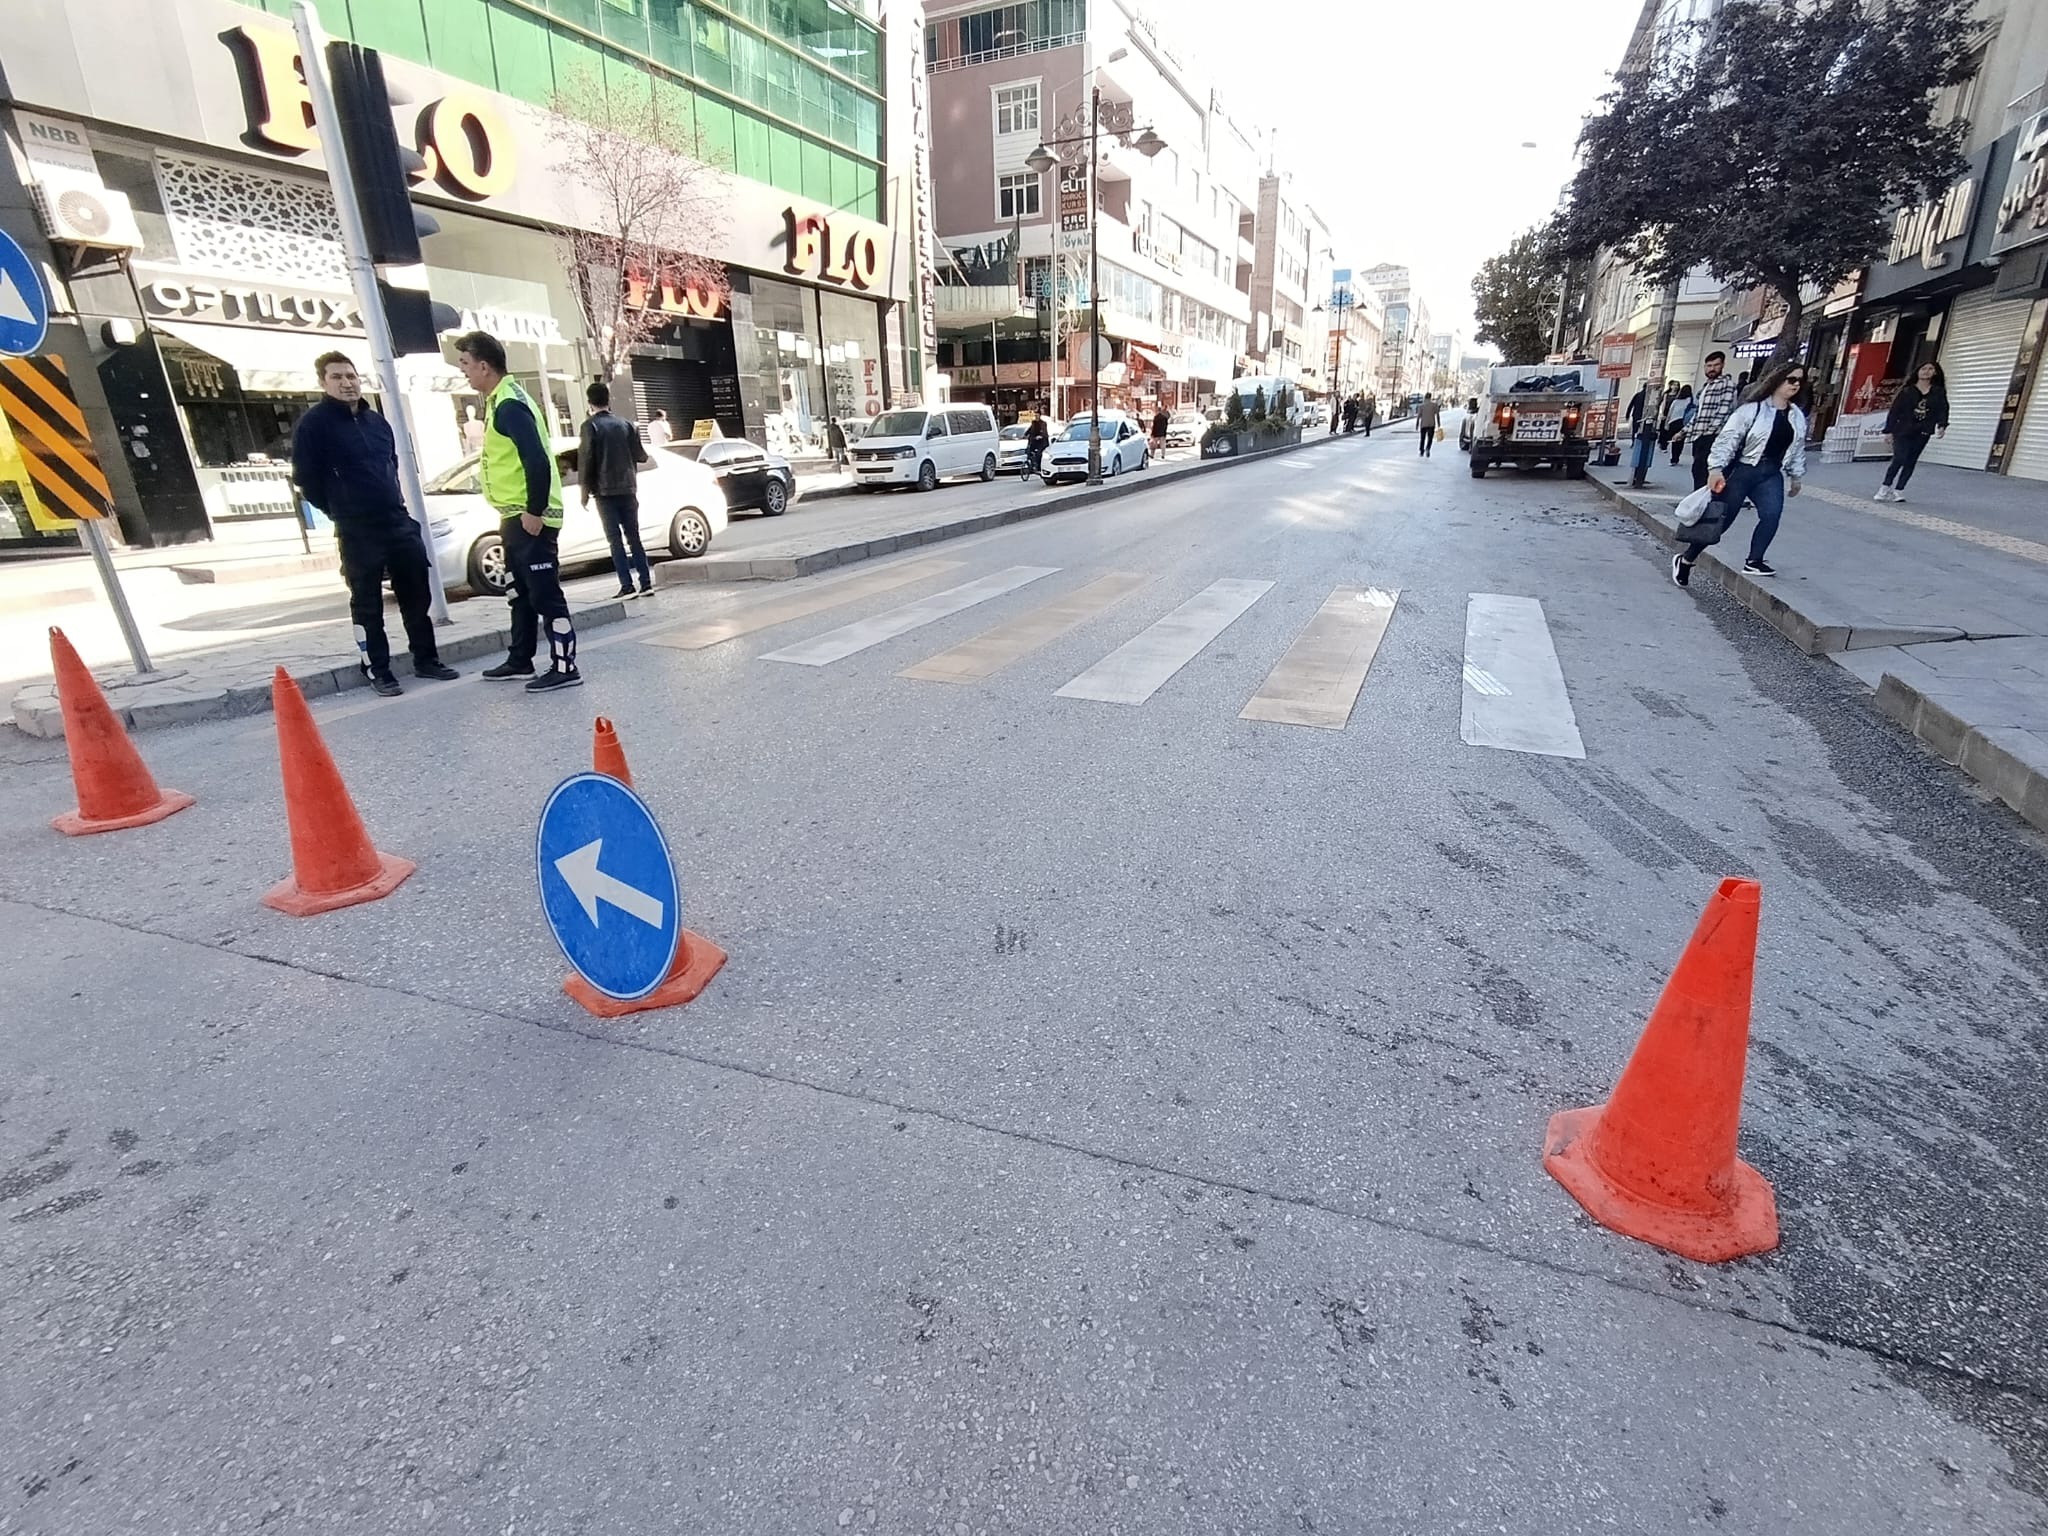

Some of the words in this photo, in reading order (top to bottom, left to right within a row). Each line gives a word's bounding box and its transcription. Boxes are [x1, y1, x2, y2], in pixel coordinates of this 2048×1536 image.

[218, 23, 516, 201] FO
[783, 206, 883, 290] FLO
[146, 279, 364, 331] OPTILUX
[863, 359, 881, 417] FLO
